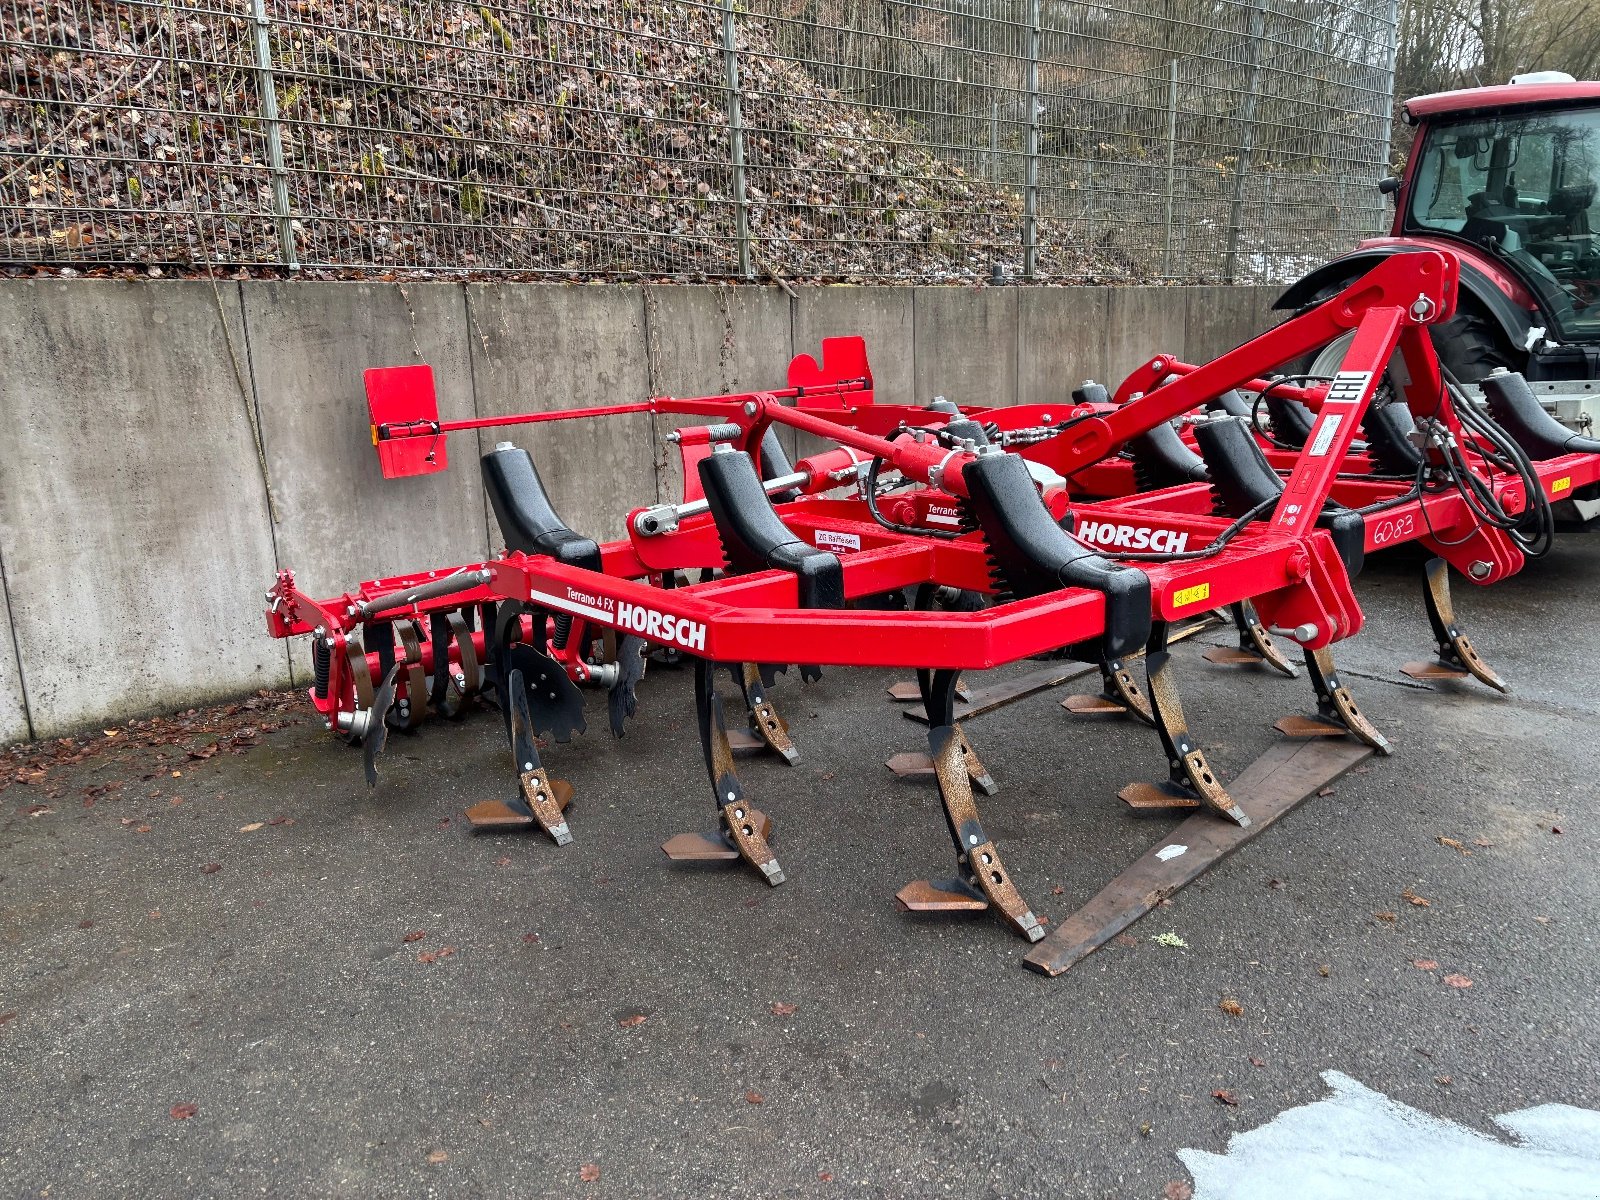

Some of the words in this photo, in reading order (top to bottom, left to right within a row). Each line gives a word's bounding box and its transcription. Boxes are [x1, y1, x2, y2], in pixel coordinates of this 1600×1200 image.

[818, 532, 827, 542] ZG
[828, 534, 857, 547] Raiffeisen
[1078, 520, 1189, 553] HORSCH
[1374, 514, 1414, 544] 6083
[566, 586, 596, 606] Terrano
[597, 596, 602, 608] 4
[604, 597, 614, 612] FX
[617, 601, 707, 651] HORSCH
